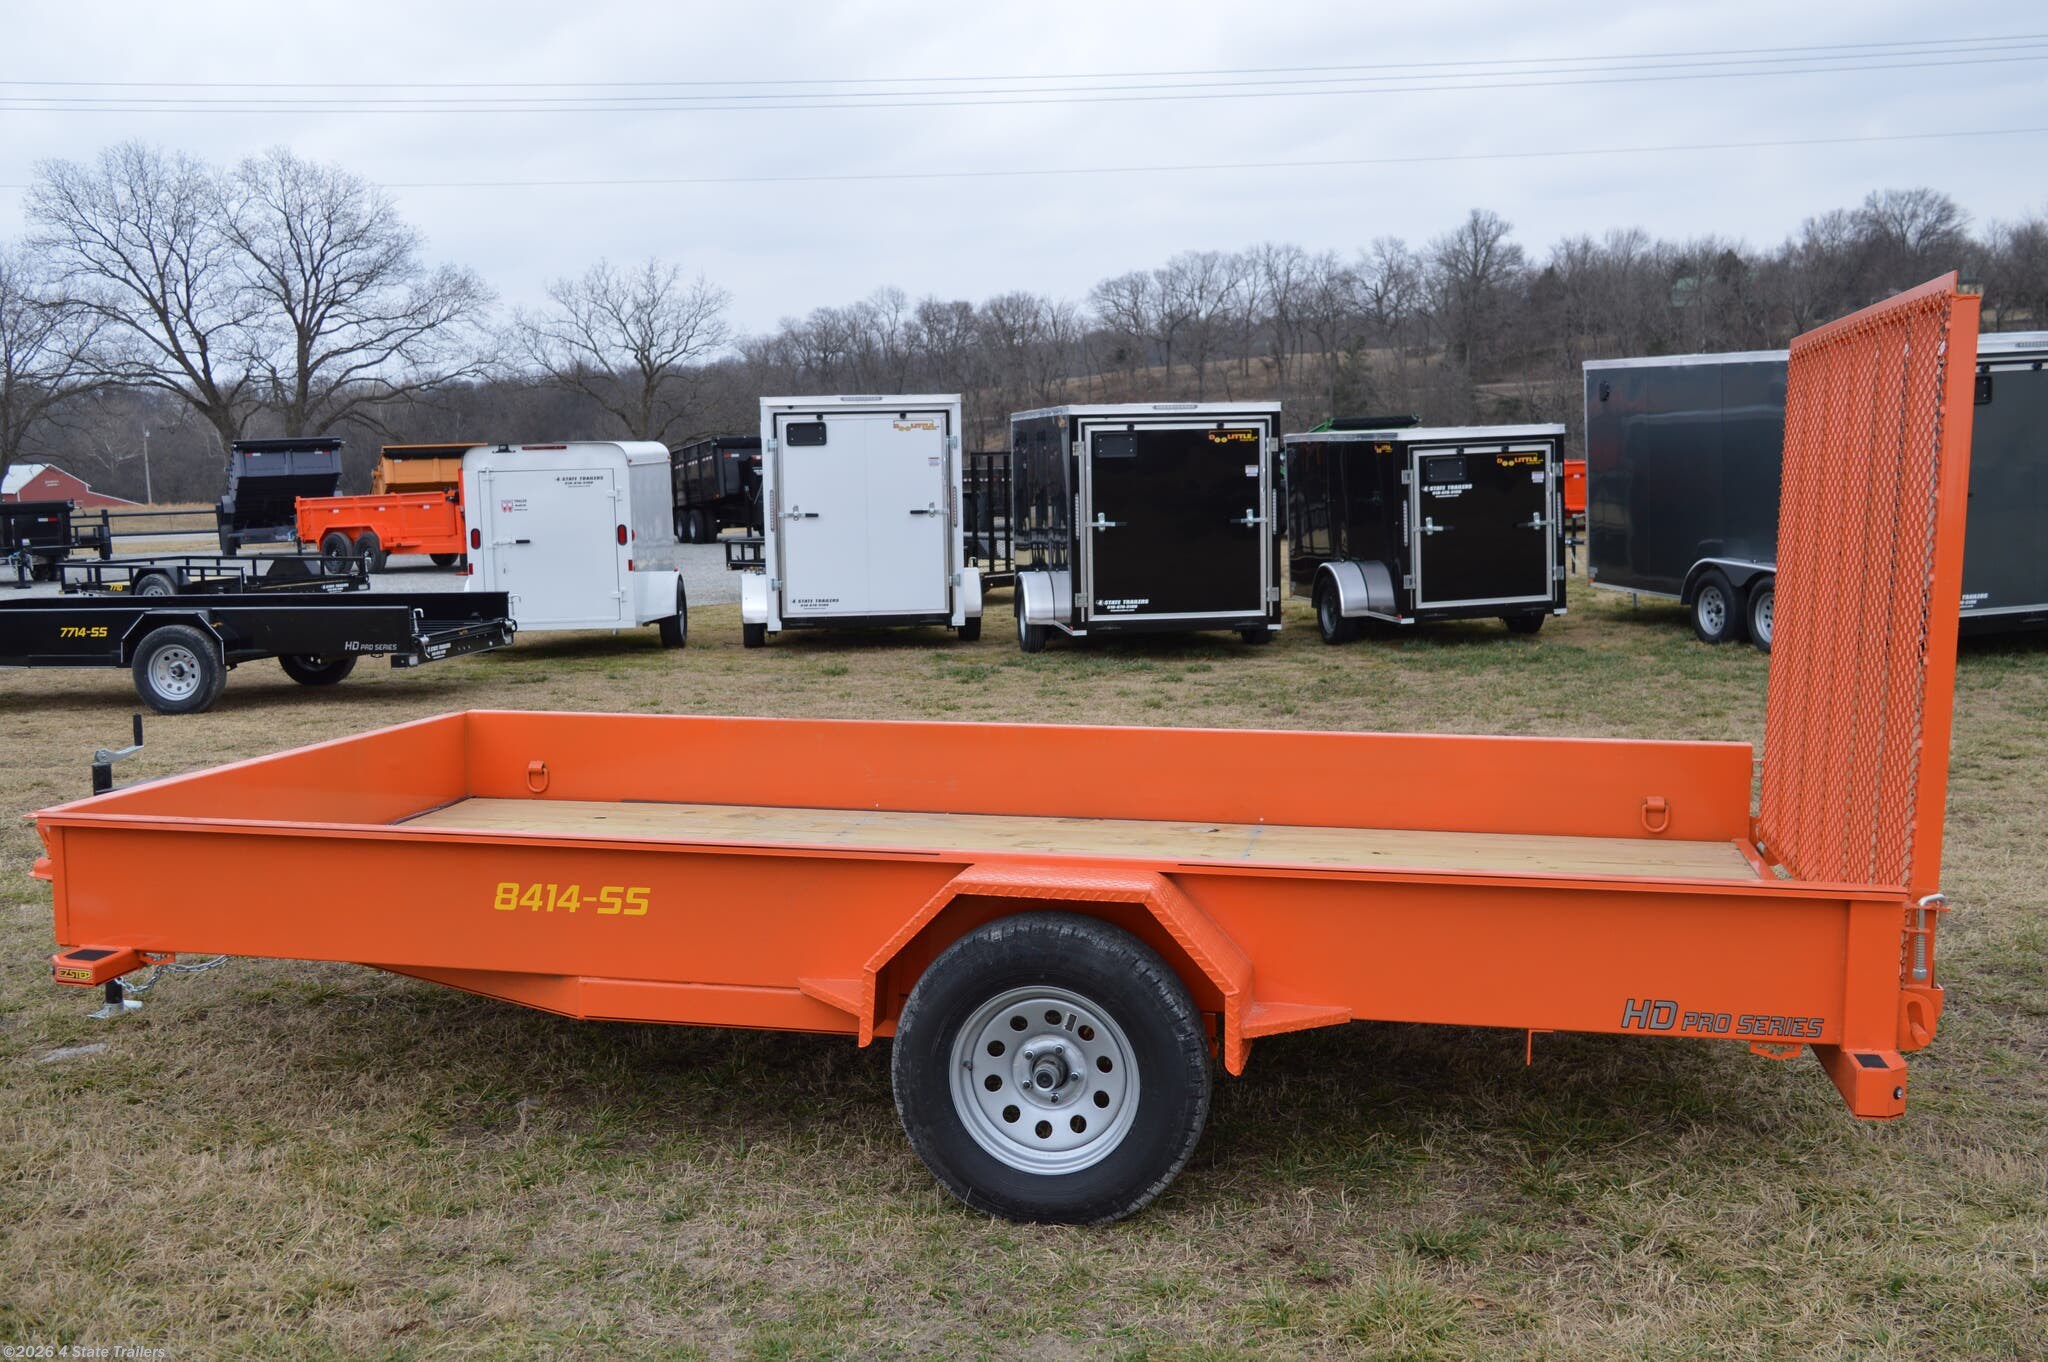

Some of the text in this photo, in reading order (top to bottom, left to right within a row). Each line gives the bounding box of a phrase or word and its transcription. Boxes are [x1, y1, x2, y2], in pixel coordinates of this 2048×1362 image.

[60, 626, 108, 638] 7714-SS
[344, 641, 360, 651] HD
[493, 881, 652, 917] 8414-SS
[1620, 998, 1825, 1038] HD PRO SERIES
